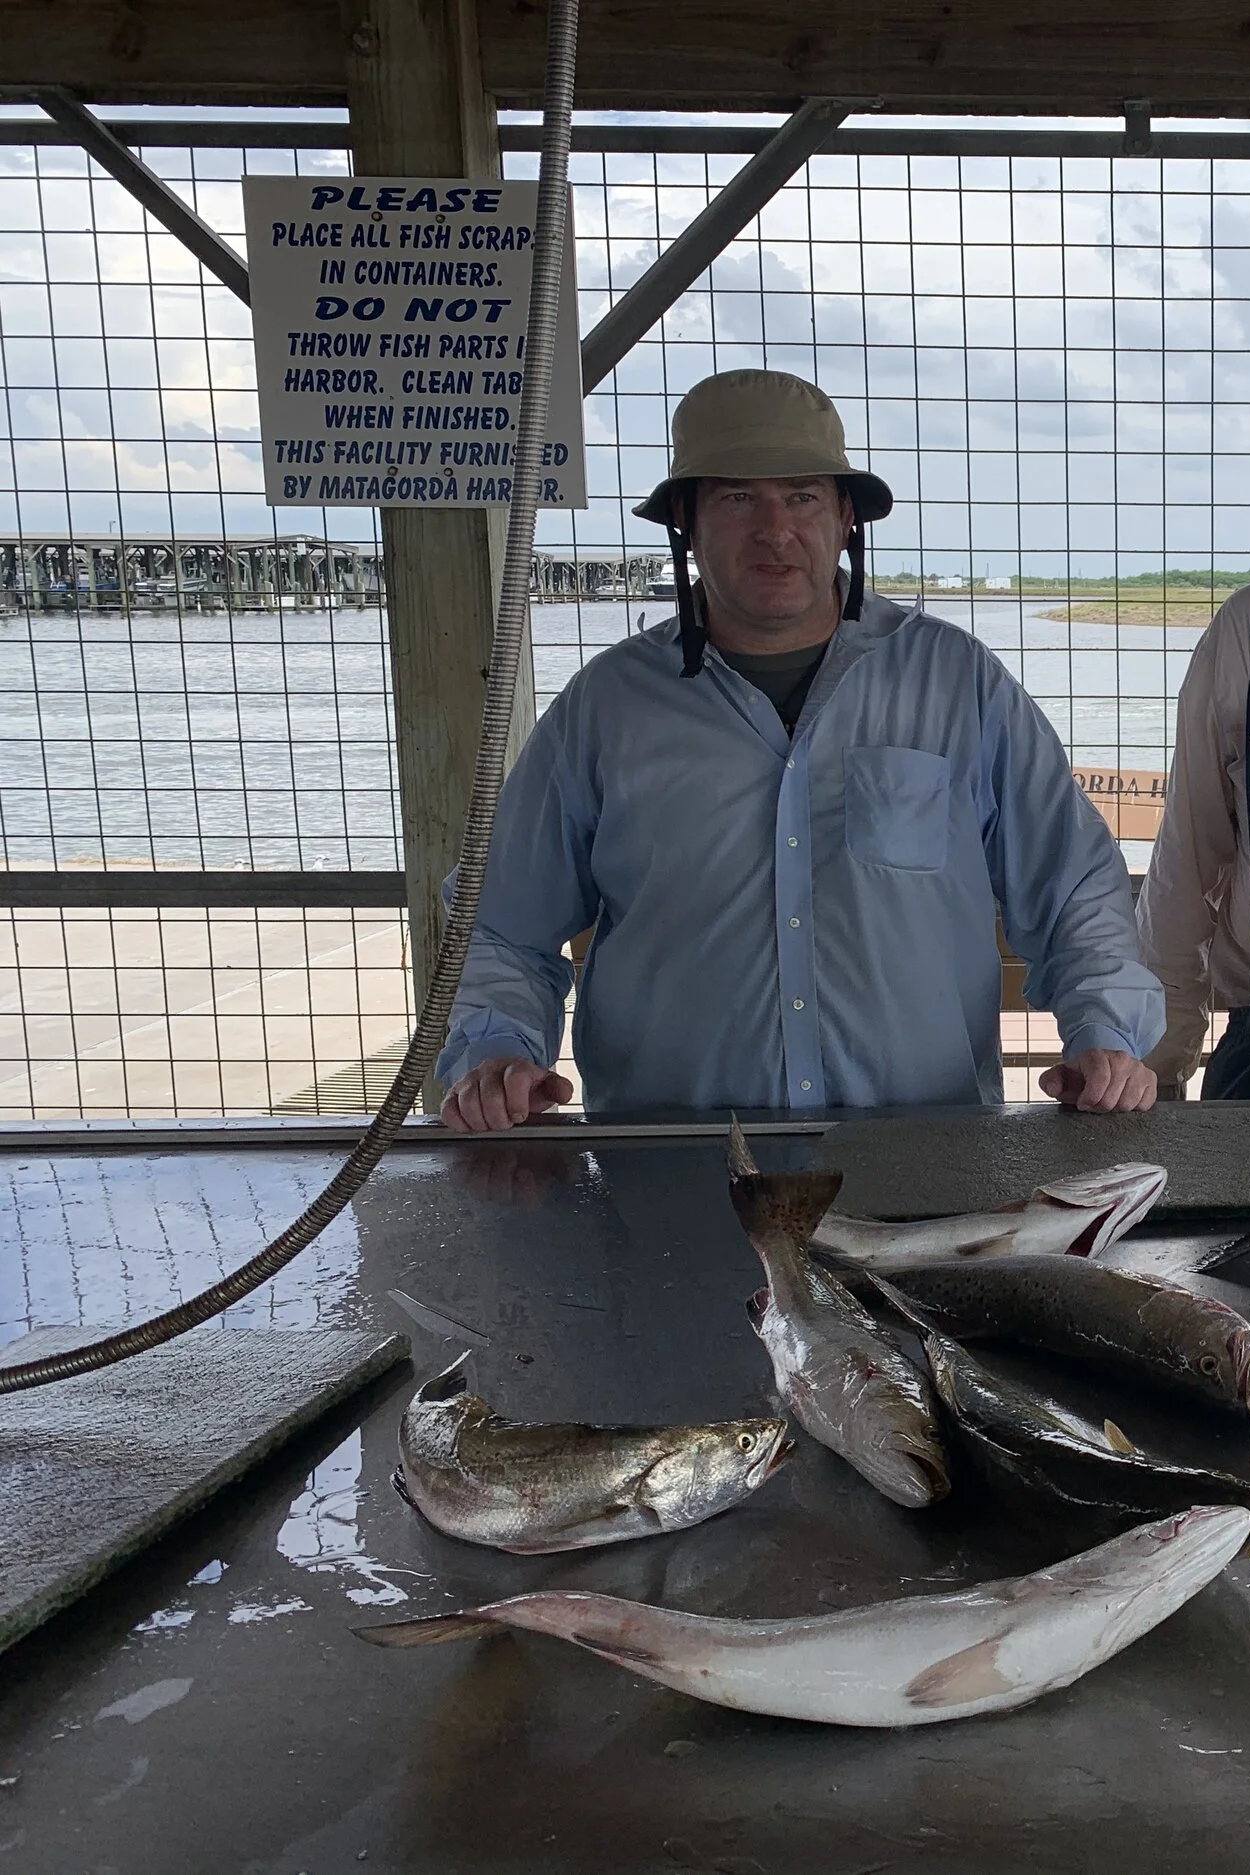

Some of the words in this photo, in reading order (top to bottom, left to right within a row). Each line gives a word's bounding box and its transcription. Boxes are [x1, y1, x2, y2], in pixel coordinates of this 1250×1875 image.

[311, 186, 503, 212] PLEASE
[272, 223, 343, 248] PLACE
[351, 223, 391, 249] ALL
[399, 224, 451, 250] FISH
[319, 260, 346, 285] IN
[354, 262, 503, 288] CONTAINERS.
[315, 297, 385, 321] DO
[404, 299, 512, 324] NOT
[288, 333, 372, 359] THROW
[379, 334, 431, 359] FISH
[439, 335, 508, 360] PARTS
[516, 337, 526, 360] I
[284, 369, 385, 395] HARBOR.
[402, 370, 473, 395] CLEAN
[482, 371, 523, 395] TAB
[325, 405, 394, 430] WHEN
[402, 406, 516, 431] FINISHED.
[274, 440, 325, 464] THIS
[334, 441, 435, 466] FACILITY
[440, 442, 569, 468] FURNISED
[283, 475, 312, 499] BY
[319, 475, 458, 501] MATAGORDA
[467, 477, 565, 503] HARR.
[1072, 773, 1140, 797] ORDA
